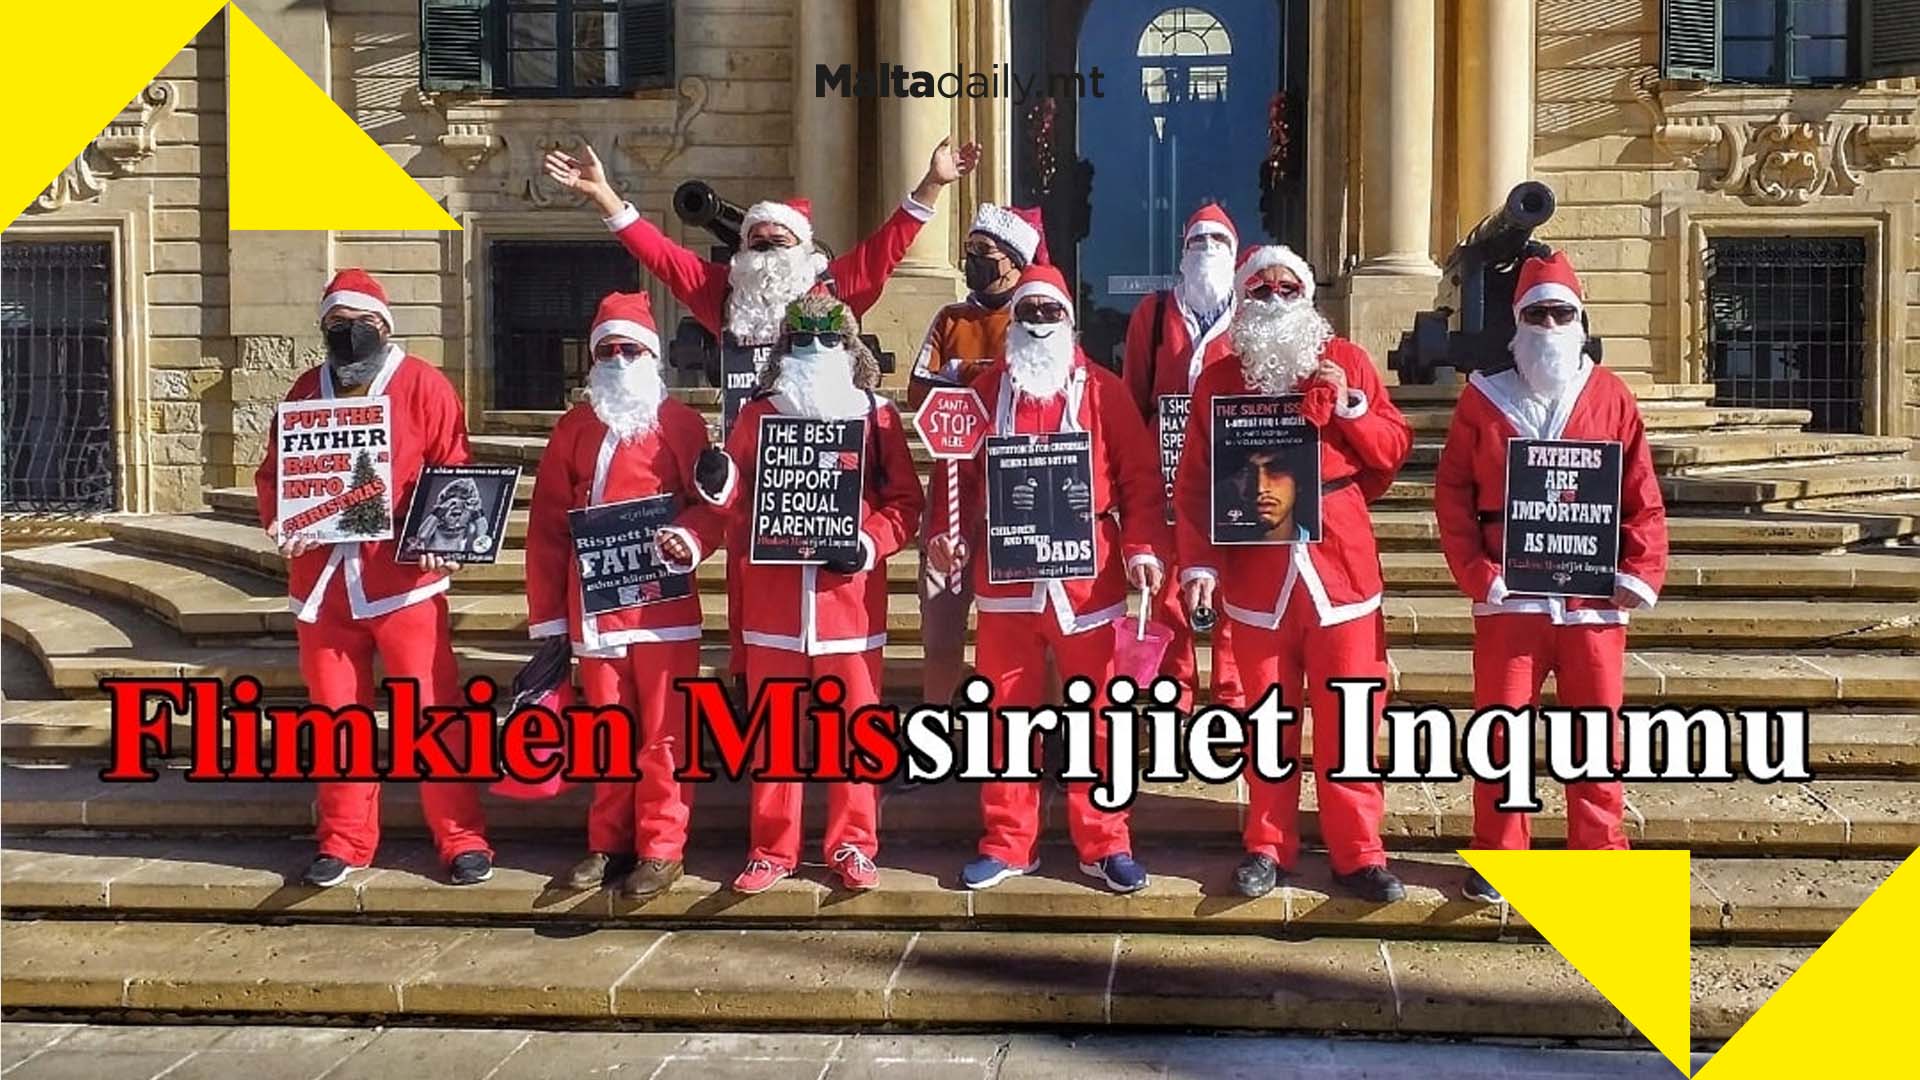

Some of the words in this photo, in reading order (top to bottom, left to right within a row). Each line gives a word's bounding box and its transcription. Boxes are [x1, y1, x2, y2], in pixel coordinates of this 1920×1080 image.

[937, 397, 970, 411] SANTA
[1215, 404, 1238, 417] THE
[1241, 403, 1281, 416] SILENT
[1283, 402, 1303, 414] ISS
[283, 409, 331, 431] PUT
[334, 405, 384, 427] THE
[929, 411, 977, 435] STOP
[283, 428, 388, 452] FATHER
[766, 423, 798, 443] THE
[804, 423, 847, 444] BEST
[941, 435, 965, 448] HERE
[283, 453, 351, 476] BACK
[764, 446, 815, 466] CHILD
[1527, 446, 1602, 469] FATHERS
[283, 476, 345, 499] INTO
[763, 468, 842, 490] SUPPORT
[1544, 469, 1579, 490] ARE
[282, 475, 387, 535] CHRISTMAS
[760, 492, 775, 512] IS
[781, 492, 839, 513] EQUAL
[1511, 500, 1613, 524] IMPORTANT
[759, 515, 854, 537] PARENTING
[991, 525, 1036, 536] CHILDREN
[576, 529, 641, 549] Rispett
[1003, 536, 1022, 546] AND
[1524, 533, 1544, 552] AS
[1547, 534, 1598, 555] MUMS
[1036, 540, 1092, 563] DADS
